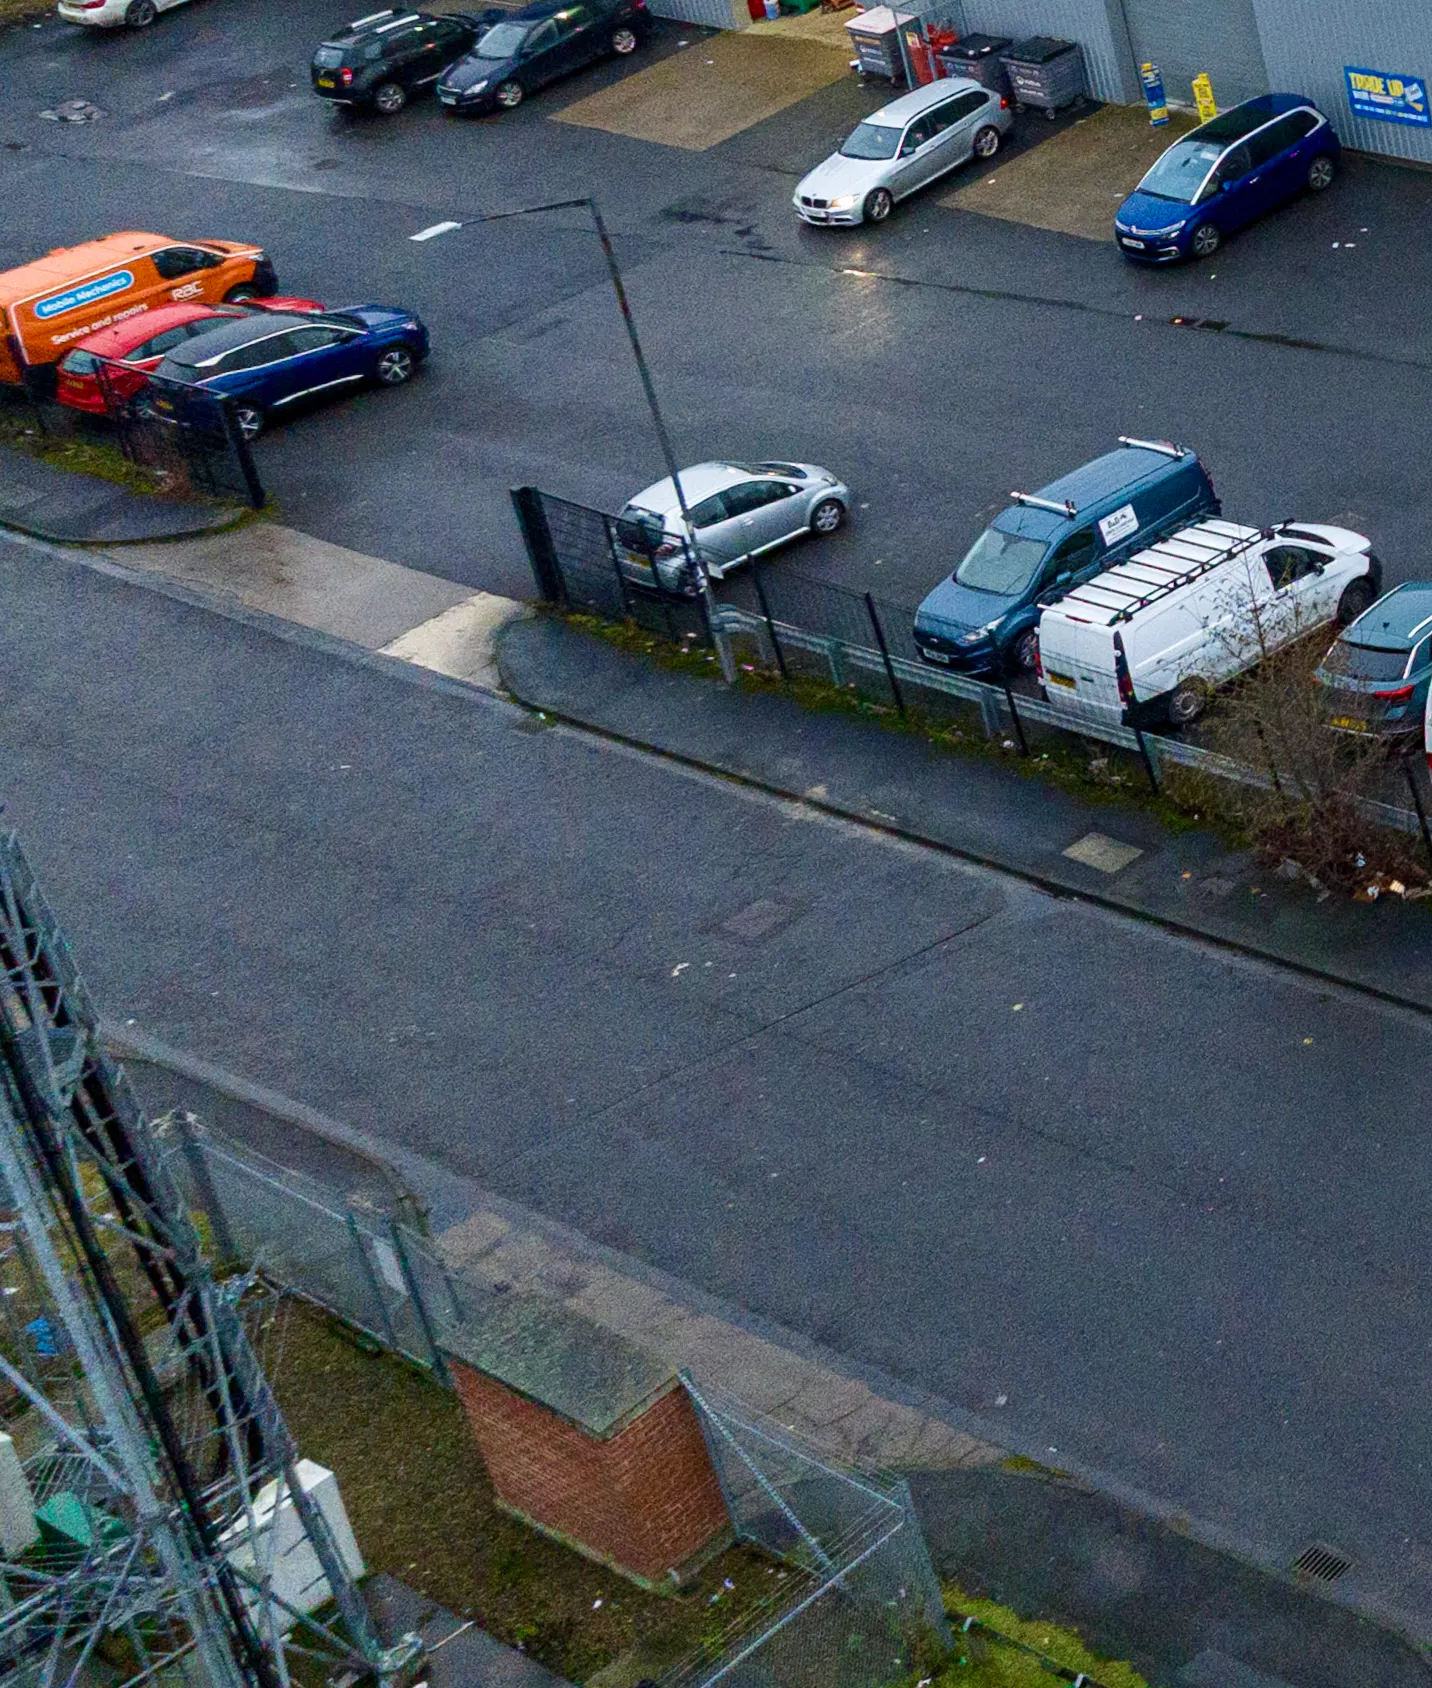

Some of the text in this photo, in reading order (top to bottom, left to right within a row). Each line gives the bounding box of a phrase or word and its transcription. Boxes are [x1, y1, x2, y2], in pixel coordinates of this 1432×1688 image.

[42, 277, 127, 314] Mobile Mechanics
[51, 303, 148, 345] Service and repairs
